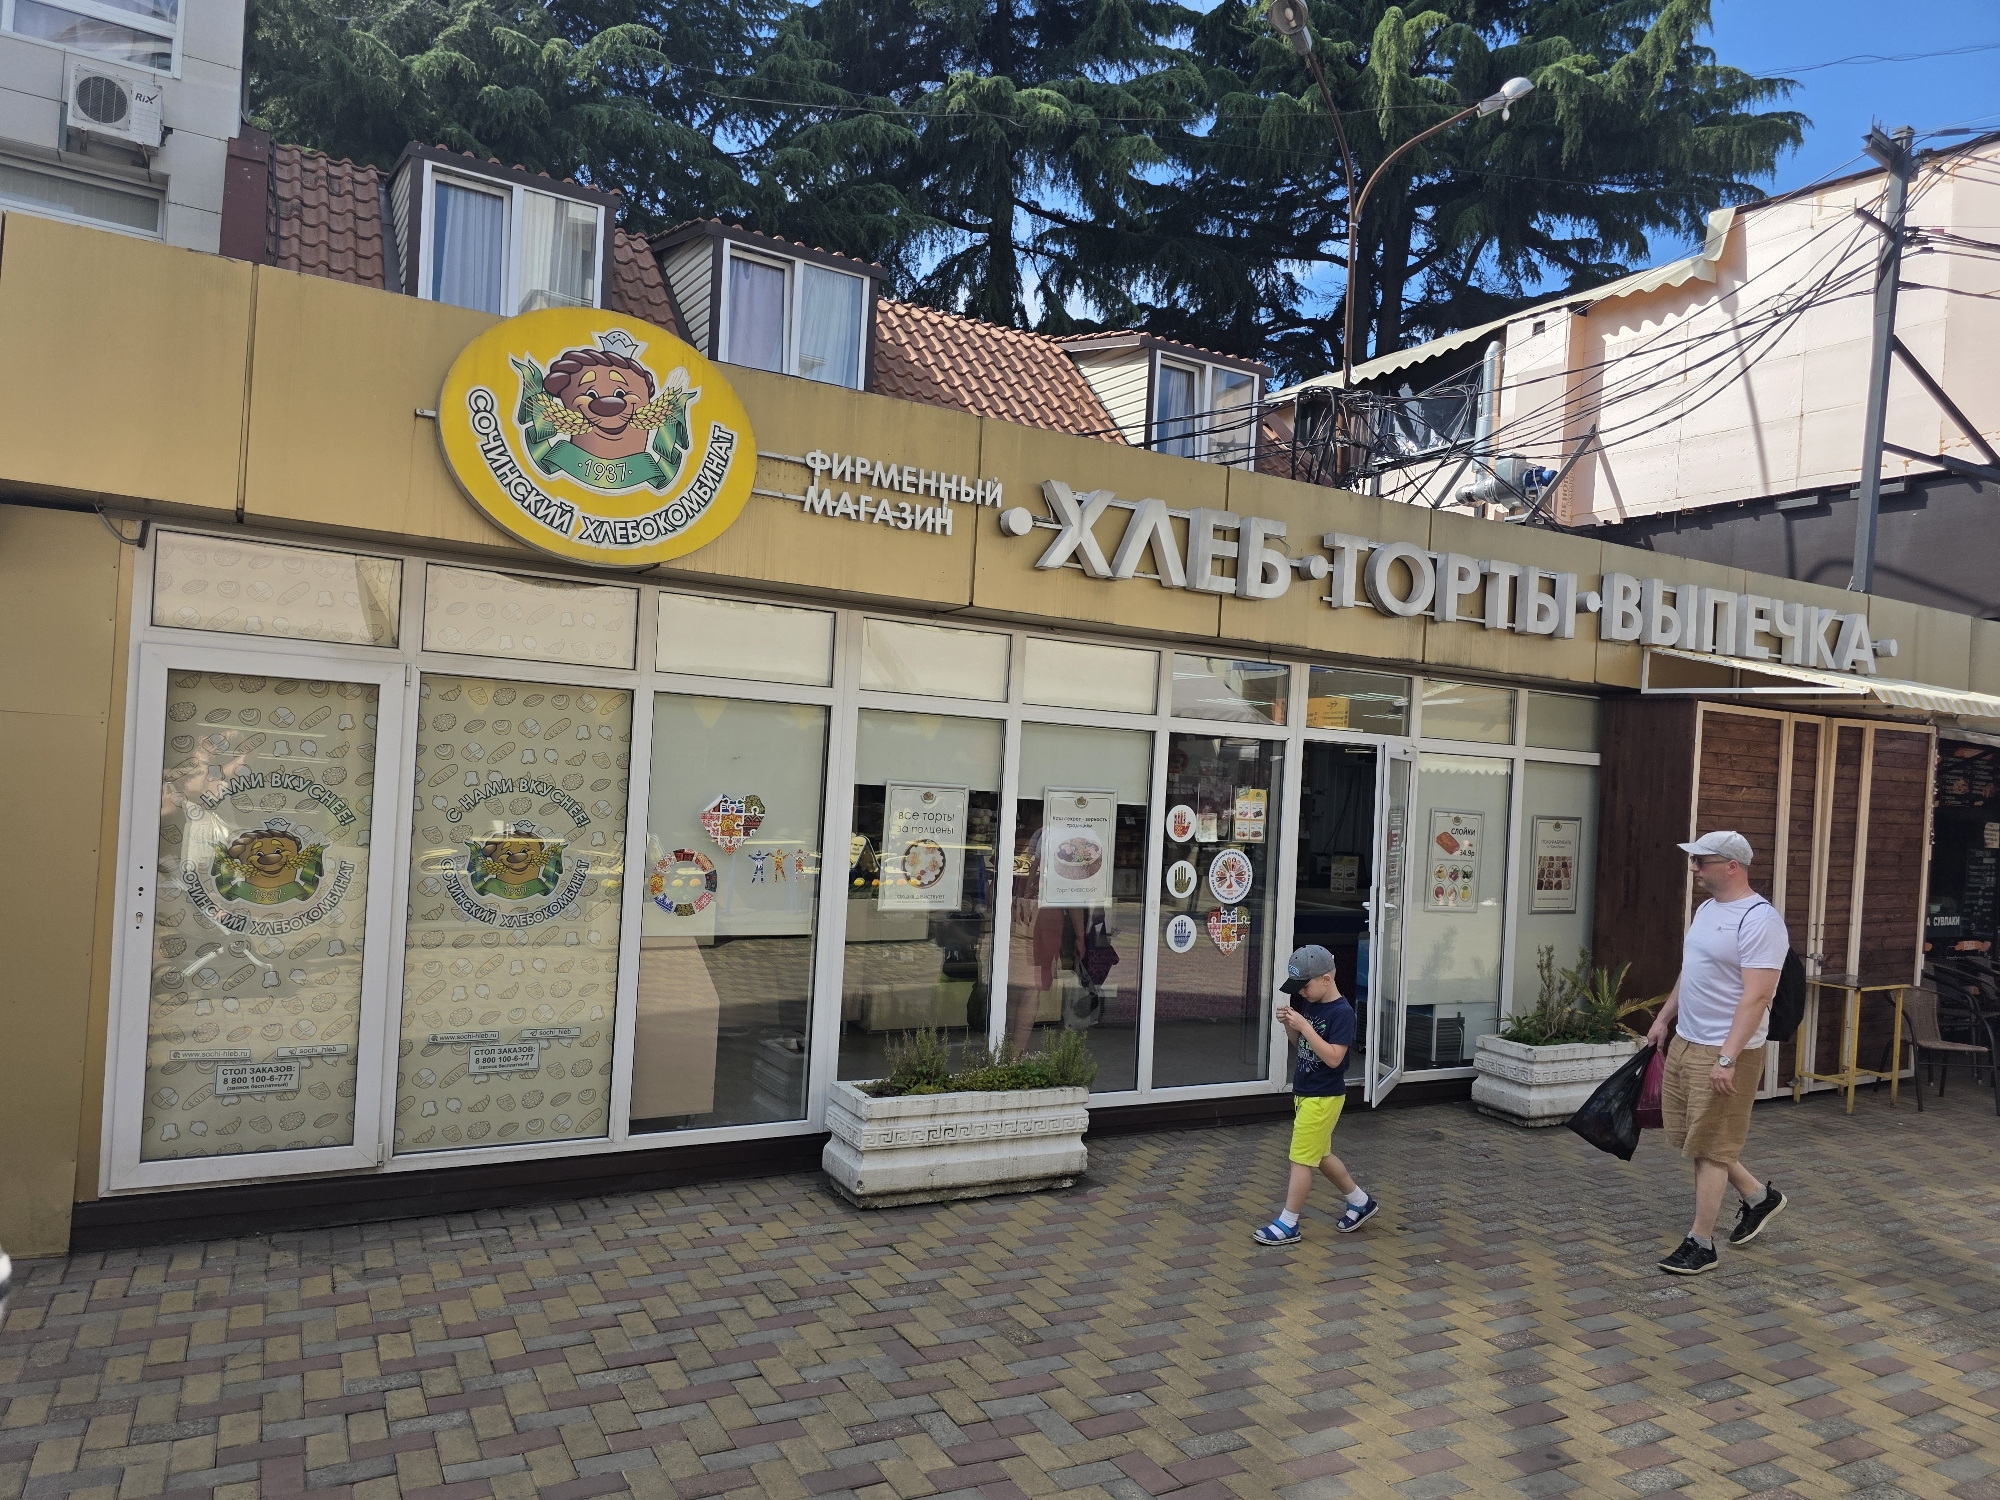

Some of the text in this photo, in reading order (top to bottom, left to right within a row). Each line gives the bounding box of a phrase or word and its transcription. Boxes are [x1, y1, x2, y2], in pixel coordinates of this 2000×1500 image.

[468, 388, 735, 544] СОЧИНСКИЙ ХЛЕБОКОМБИНАТ
[584, 459, 627, 484] 1937
[804, 449, 1003, 508] ФИРМЕННЫЙ
[803, 486, 953, 536] МАГАЗИН
[1035, 479, 1878, 675] ХЛЕБ ТОРТЫ ВЫПЕЧКА
[186, 772, 357, 826] С НАМИ ВКУСНЕЕ!
[446, 778, 591, 828] С НАМИ ВКУСНЕЕ!
[911, 826, 954, 835] полцены
[1451, 827, 1476, 836] СЛОЙКИ
[181, 860, 354, 936] СОЧИНСКИЙ ХЛЕБОКОМБИНАТ
[440, 858, 590, 928] СОЧИНСКИЙ ХЛЕБОКОМБИНАТ
[222, 1065, 296, 1076] СТОЛ ЗАКАЗОВ:
[497, 1046, 536, 1055] ЗАКАЗОВ:
[223, 1074, 294, 1085] 8 800 100-6-777
